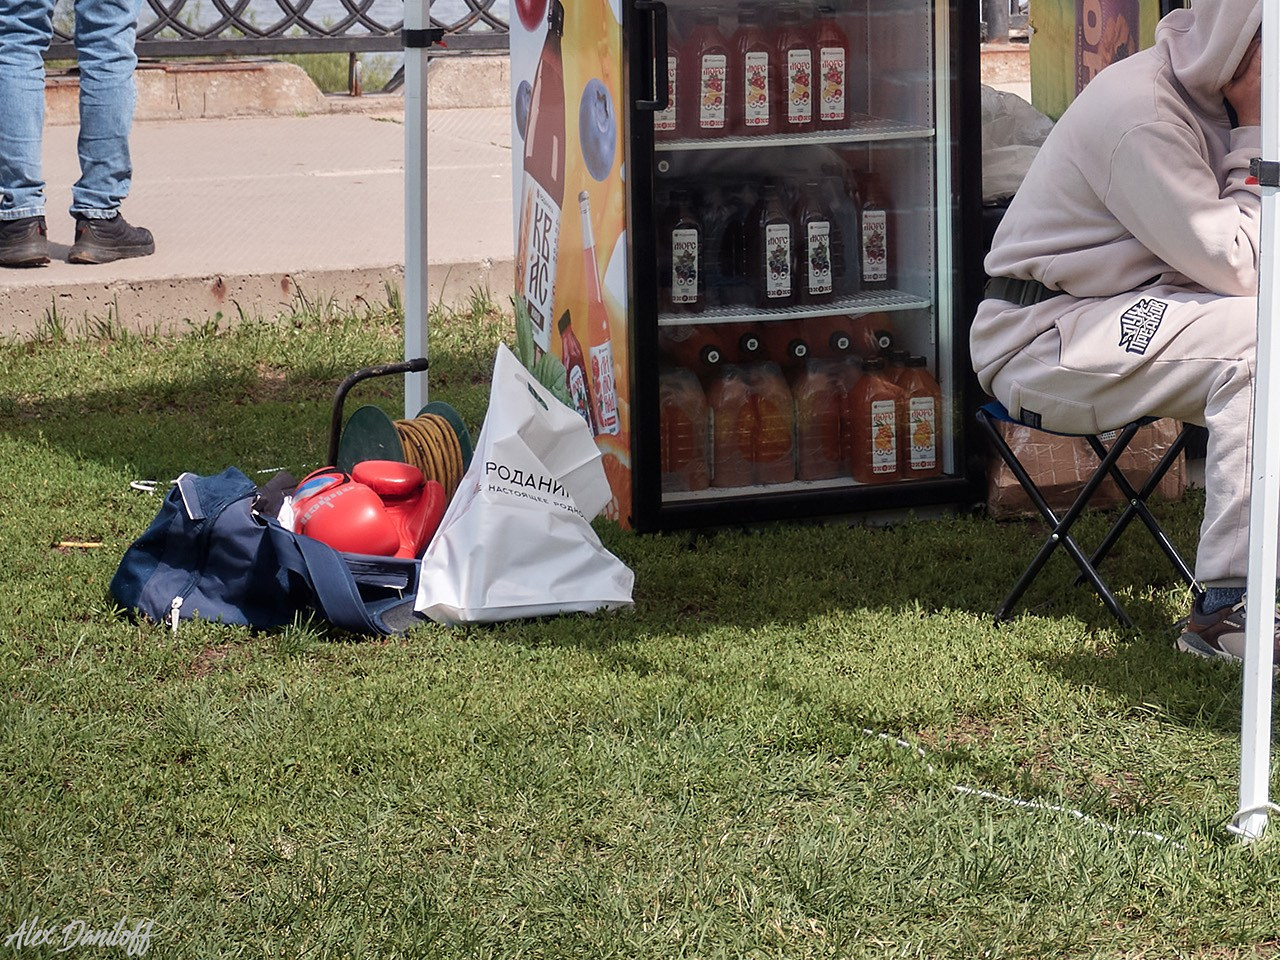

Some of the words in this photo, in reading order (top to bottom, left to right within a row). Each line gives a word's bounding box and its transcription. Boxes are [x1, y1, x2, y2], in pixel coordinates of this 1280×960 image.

[533, 202, 552, 264] КВ
[486, 462, 569, 498] РОДАНИ
[489, 484, 549, 504] НАСТОЯЩЕЕ
